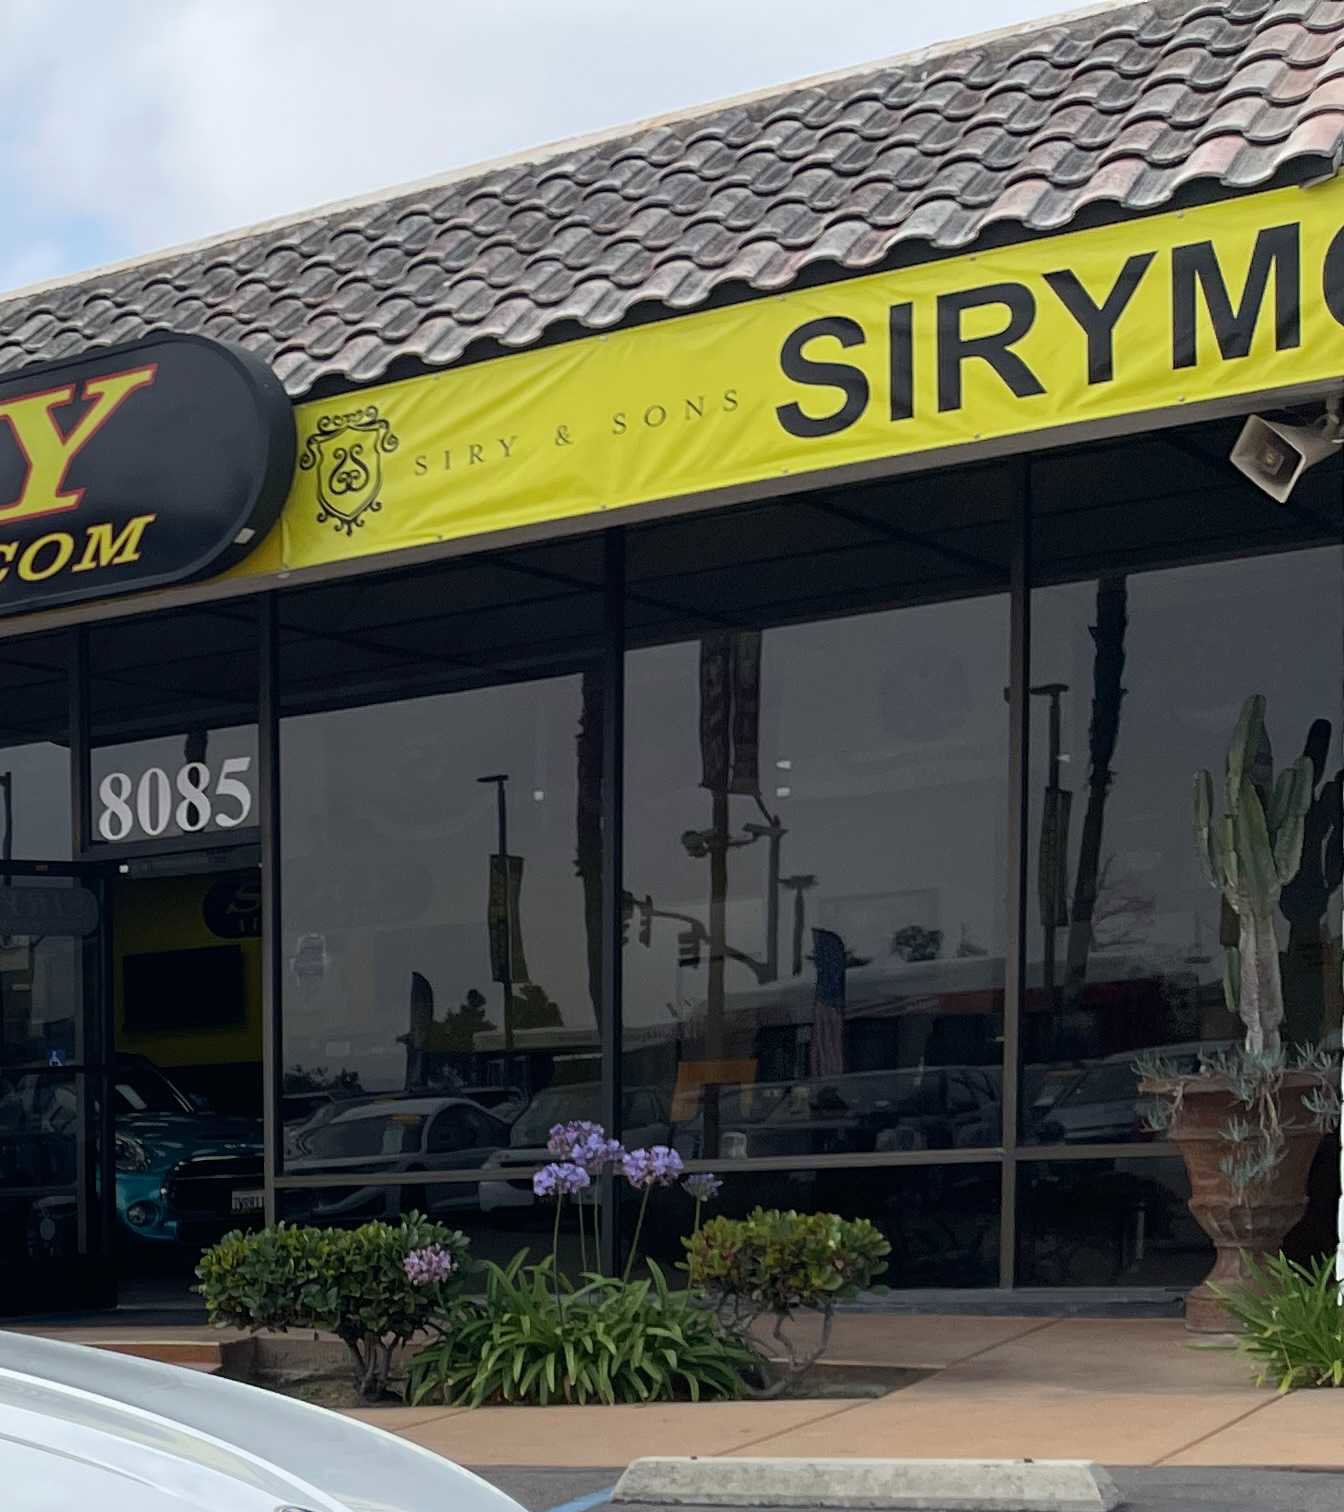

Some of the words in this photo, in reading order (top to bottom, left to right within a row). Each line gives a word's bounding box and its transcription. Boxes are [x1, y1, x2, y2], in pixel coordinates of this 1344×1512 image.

[776, 221, 1344, 438] SIRYM
[414, 436, 518, 476] SIRY
[555, 425, 573, 446] &
[612, 389, 739, 435] SONS
[98, 756, 251, 841] 8085
